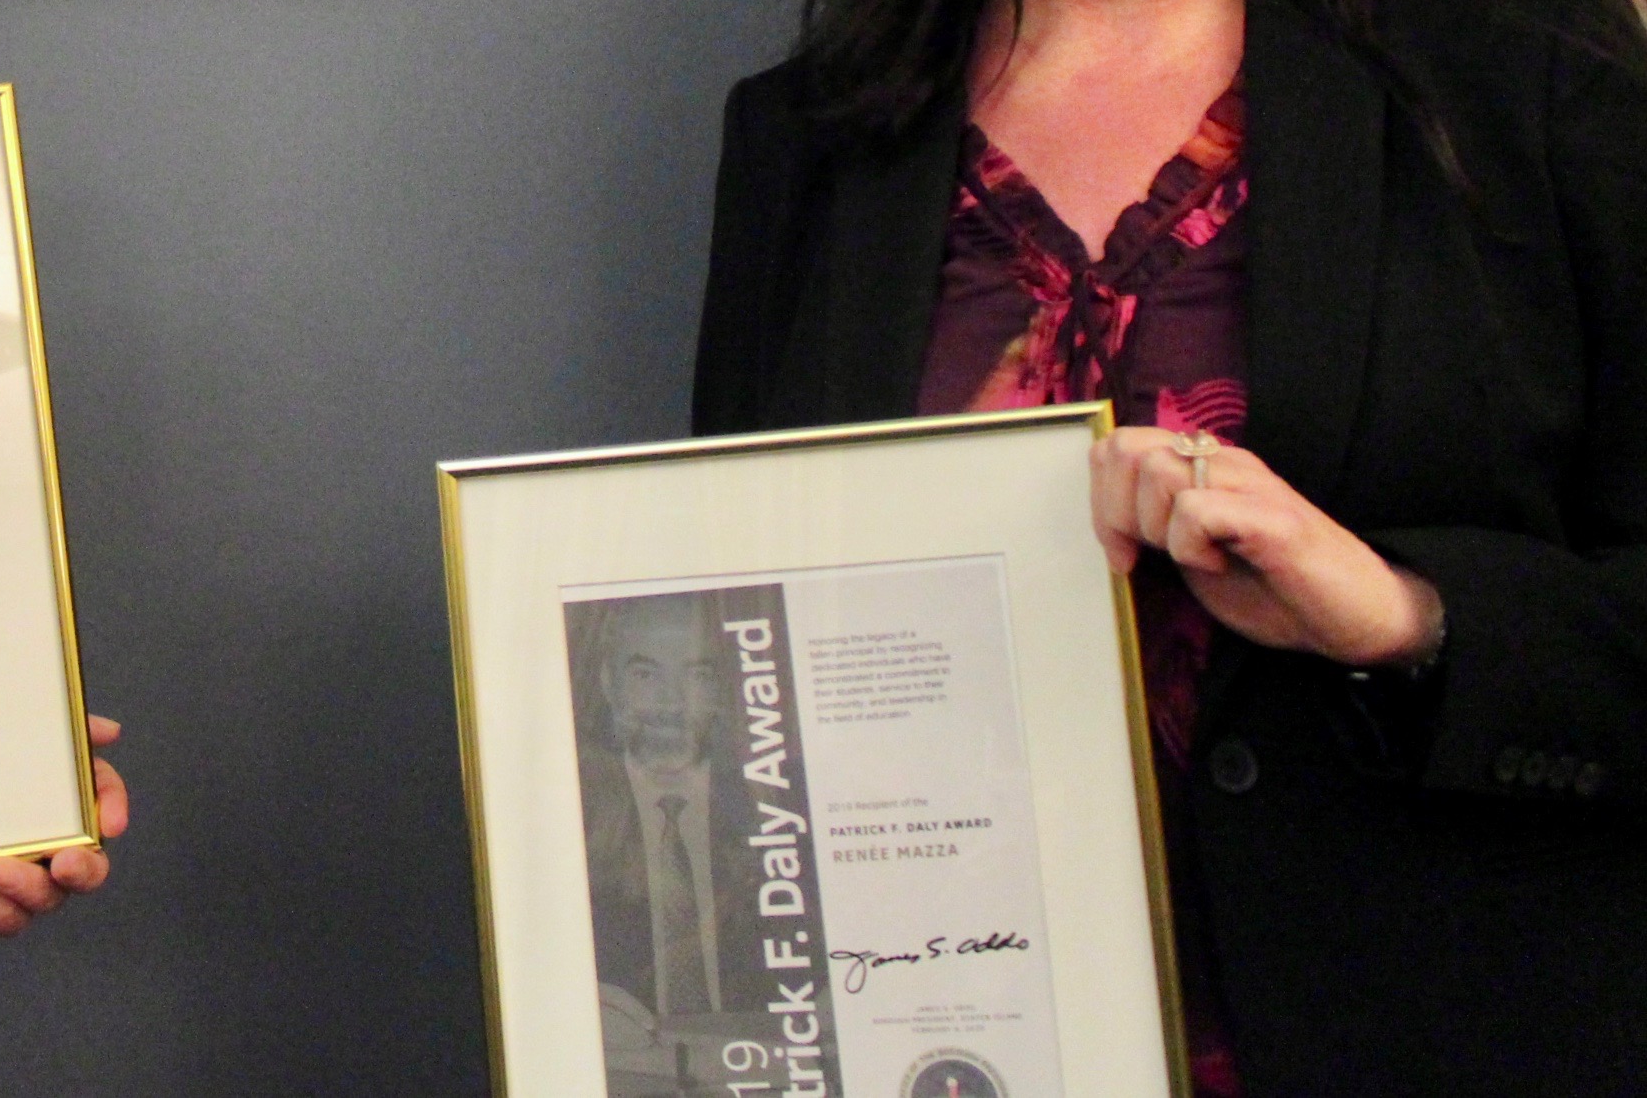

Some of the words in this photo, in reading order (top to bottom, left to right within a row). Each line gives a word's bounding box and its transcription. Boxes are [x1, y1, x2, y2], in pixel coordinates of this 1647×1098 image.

[723, 618, 790, 789] Award
[830, 825, 886, 837] PATRICK
[907, 821, 939, 833] DALY
[945, 818, 992, 830] AWARD
[748, 802, 807, 917] Daly
[897, 844, 959, 859] MAZZA
[763, 930, 811, 969] F.
